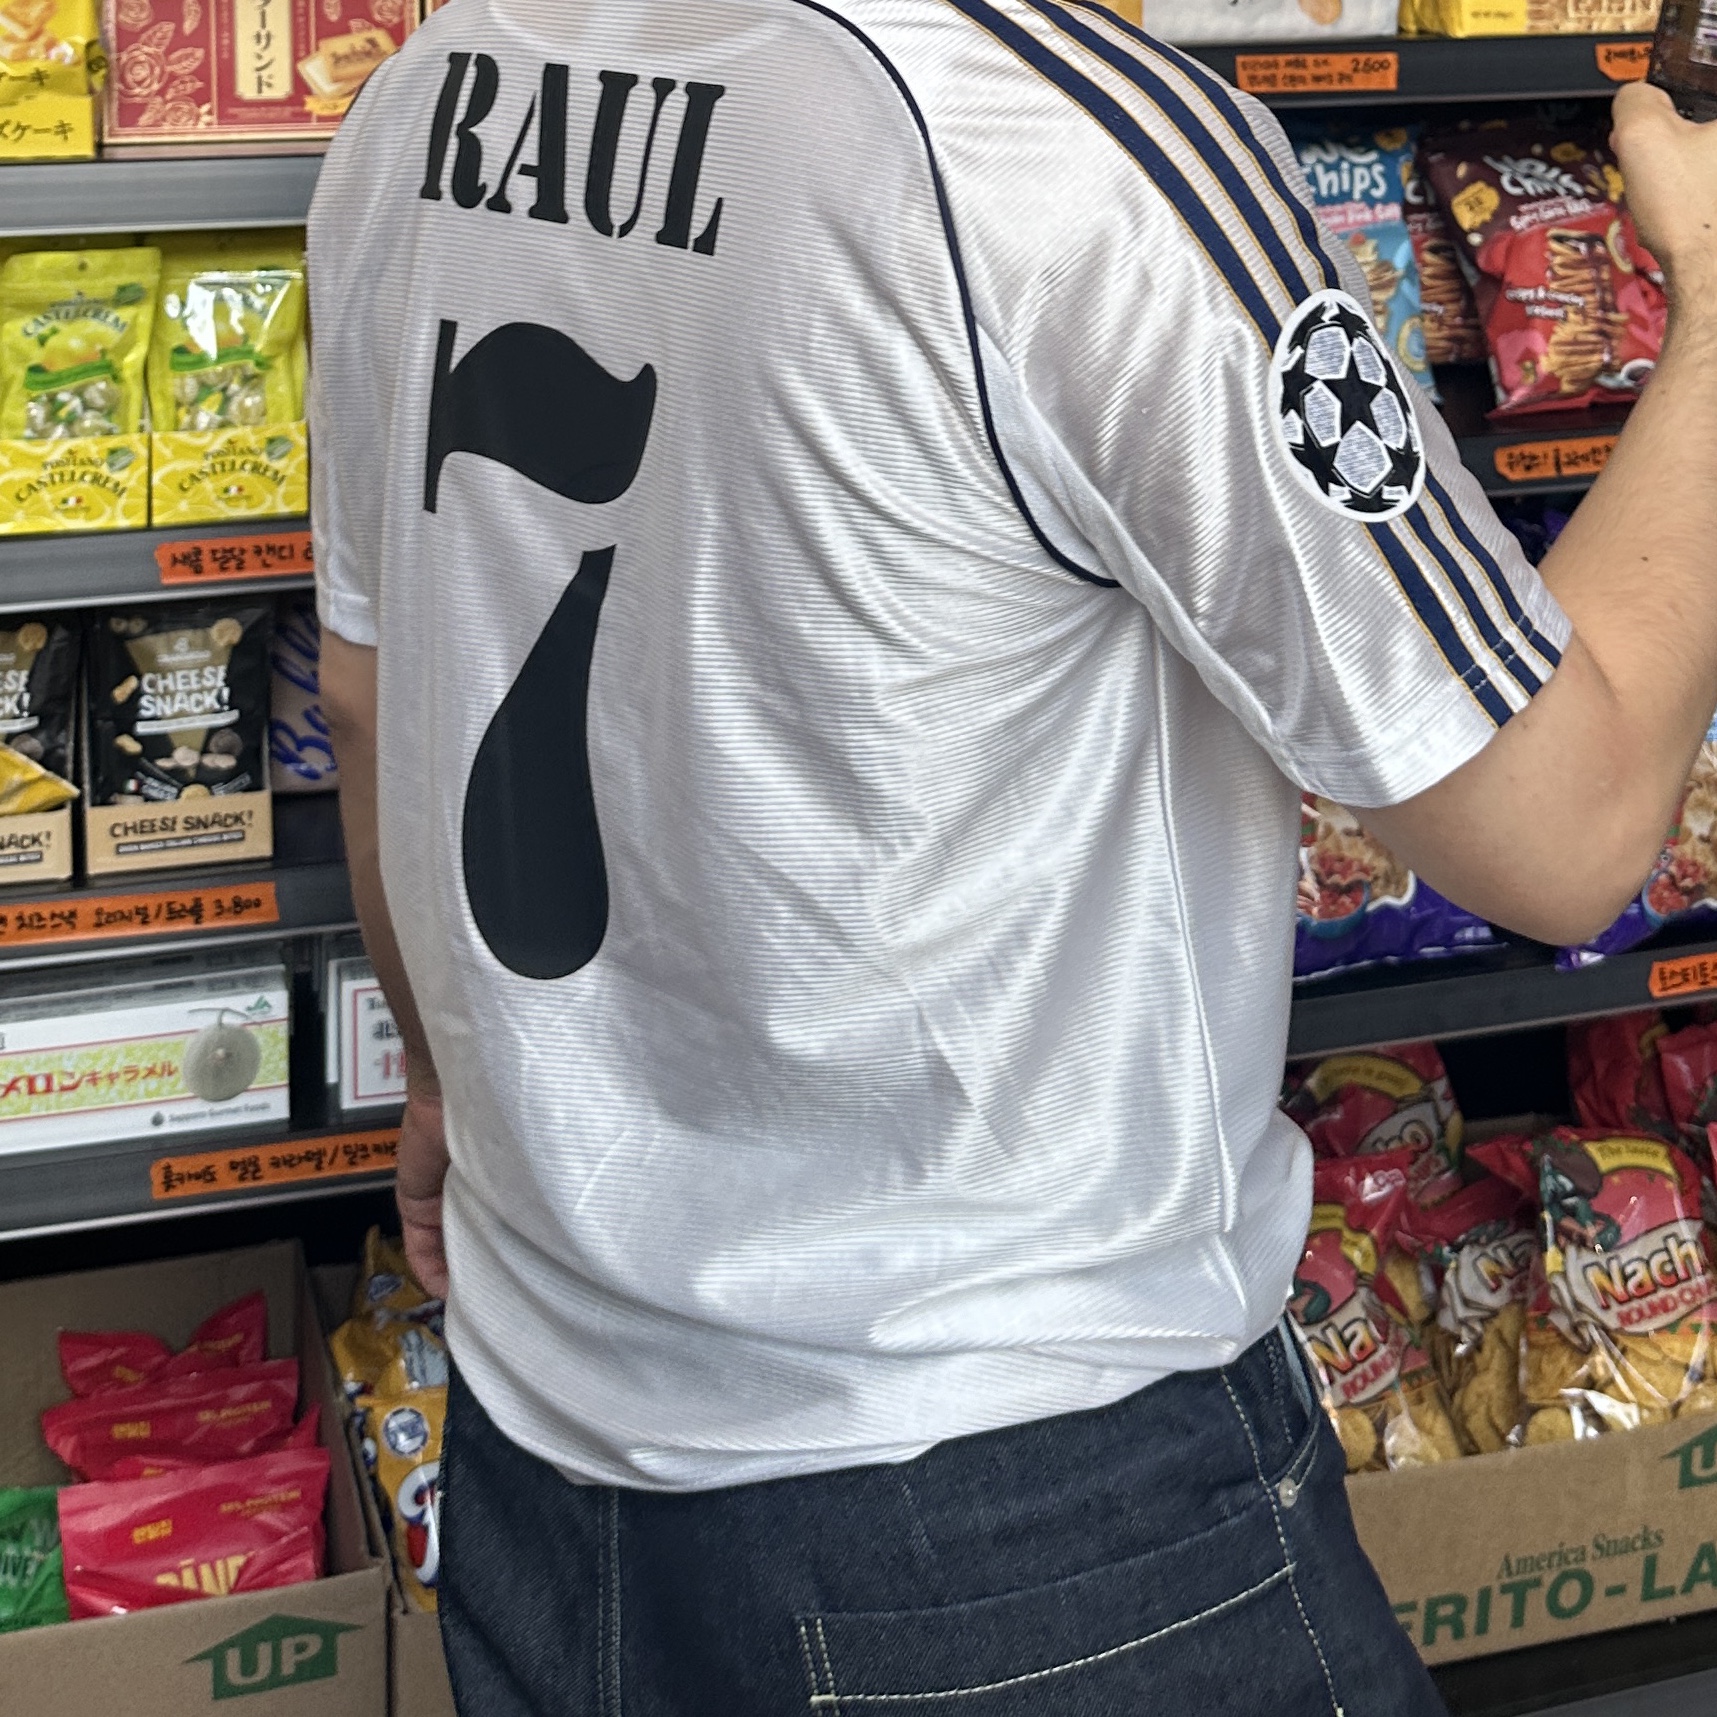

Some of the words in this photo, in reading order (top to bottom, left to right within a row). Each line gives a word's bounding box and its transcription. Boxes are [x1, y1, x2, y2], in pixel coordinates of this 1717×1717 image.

[420, 52, 726, 256] RAUL
[1302, 160, 1388, 201] hips
[423, 318, 658, 980] 7
[137, 686, 231, 720] SNACK!
[182, 810, 254, 831] SNACK!
[0, 1060, 179, 1098] メロンキャラメル
[1497, 1542, 1587, 1579] America
[1592, 1524, 1665, 1561] Snacks
[226, 1634, 323, 1686] UP
